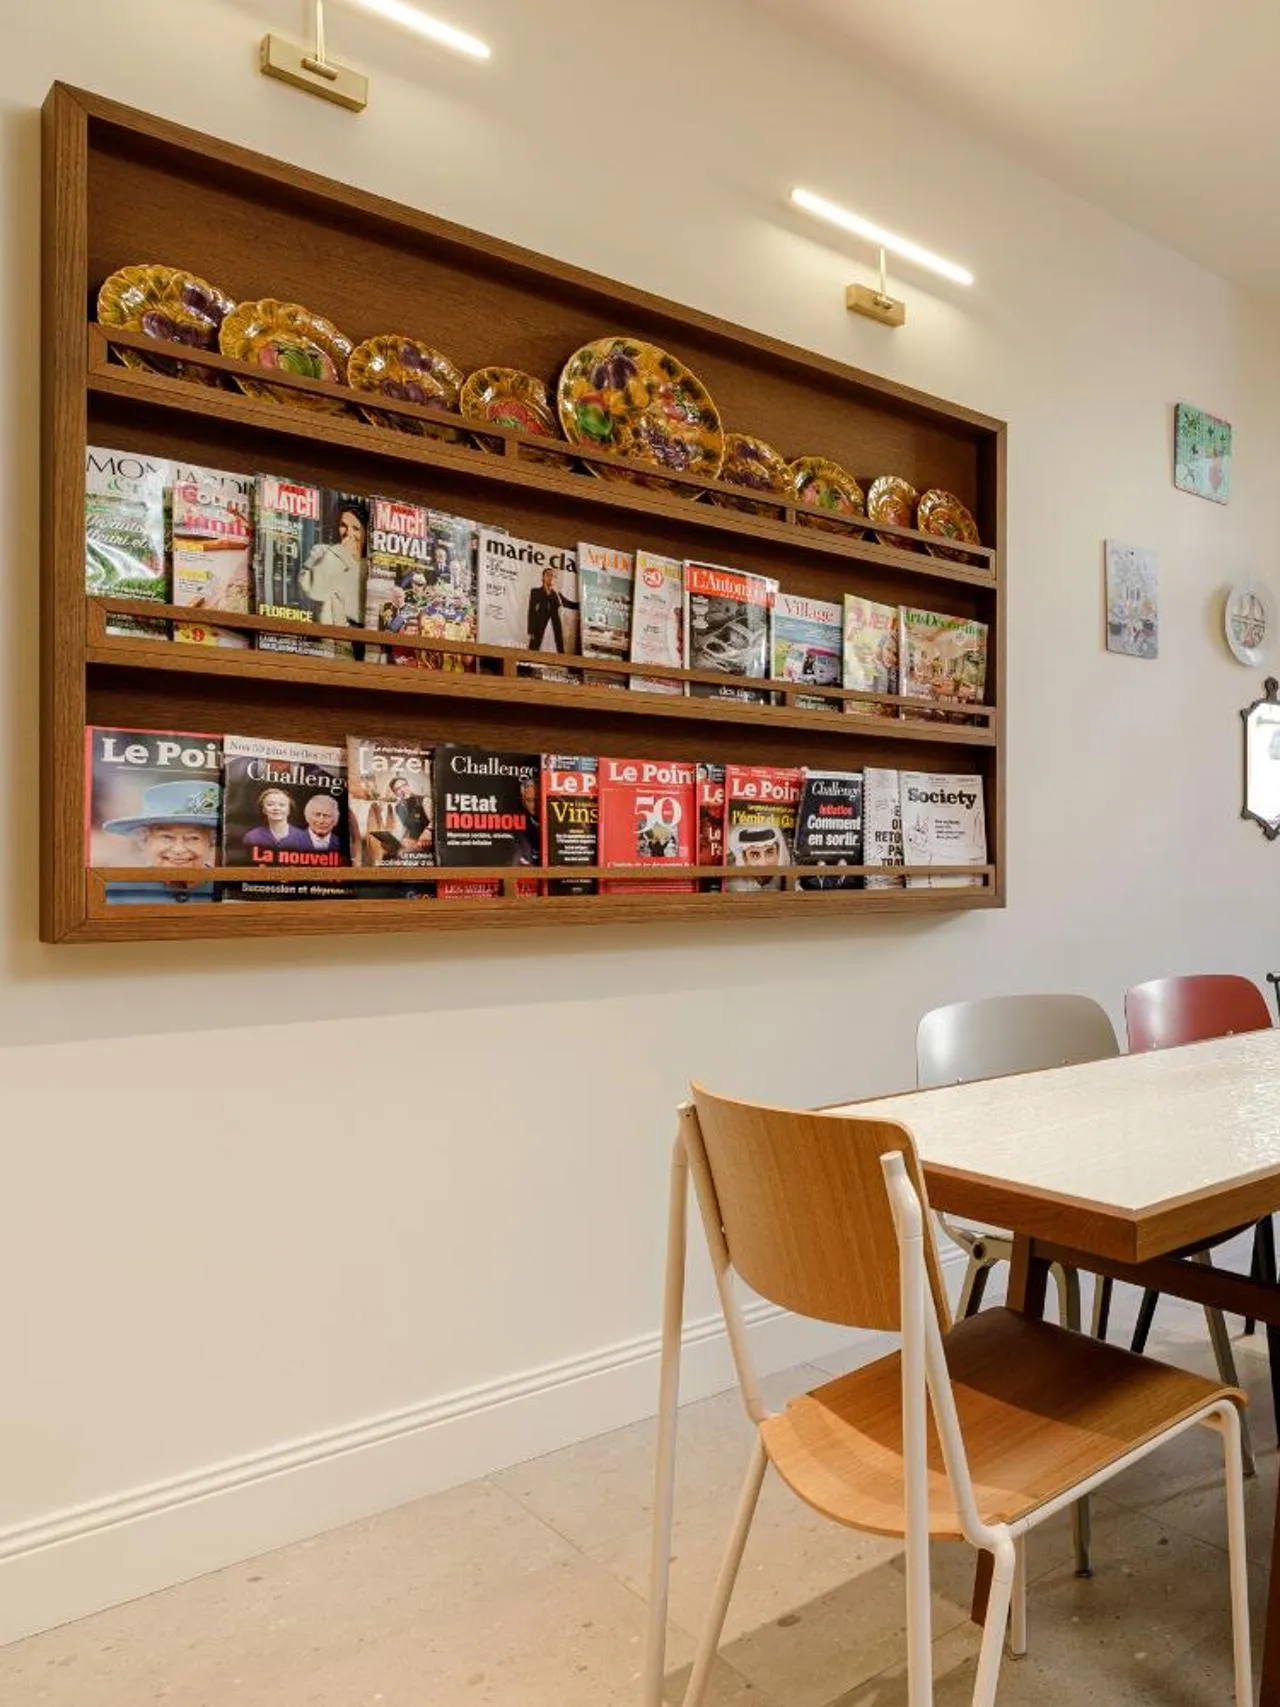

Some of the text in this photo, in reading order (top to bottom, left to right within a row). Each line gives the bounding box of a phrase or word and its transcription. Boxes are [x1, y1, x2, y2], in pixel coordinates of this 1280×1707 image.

[264, 480, 319, 520] MATCH
[375, 500, 427, 538] MATCH
[373, 531, 431, 561] ROYAL
[486, 538, 545, 566] marie
[259, 604, 313, 623] FLORENCE
[784, 598, 834, 622] Village
[102, 738, 221, 769] Le Poi
[551, 772, 577, 793] Le
[608, 762, 637, 782] Le
[703, 785, 724, 803] Le
[732, 778, 757, 798] Le
[907, 787, 977, 809] Society
[446, 794, 497, 812] L'Etat
[551, 801, 598, 823] Vins
[446, 812, 526, 830] nounou
[634, 796, 682, 834] 50
[807, 815, 862, 830] Comment
[808, 833, 823, 846] en
[253, 846, 273, 862] La
